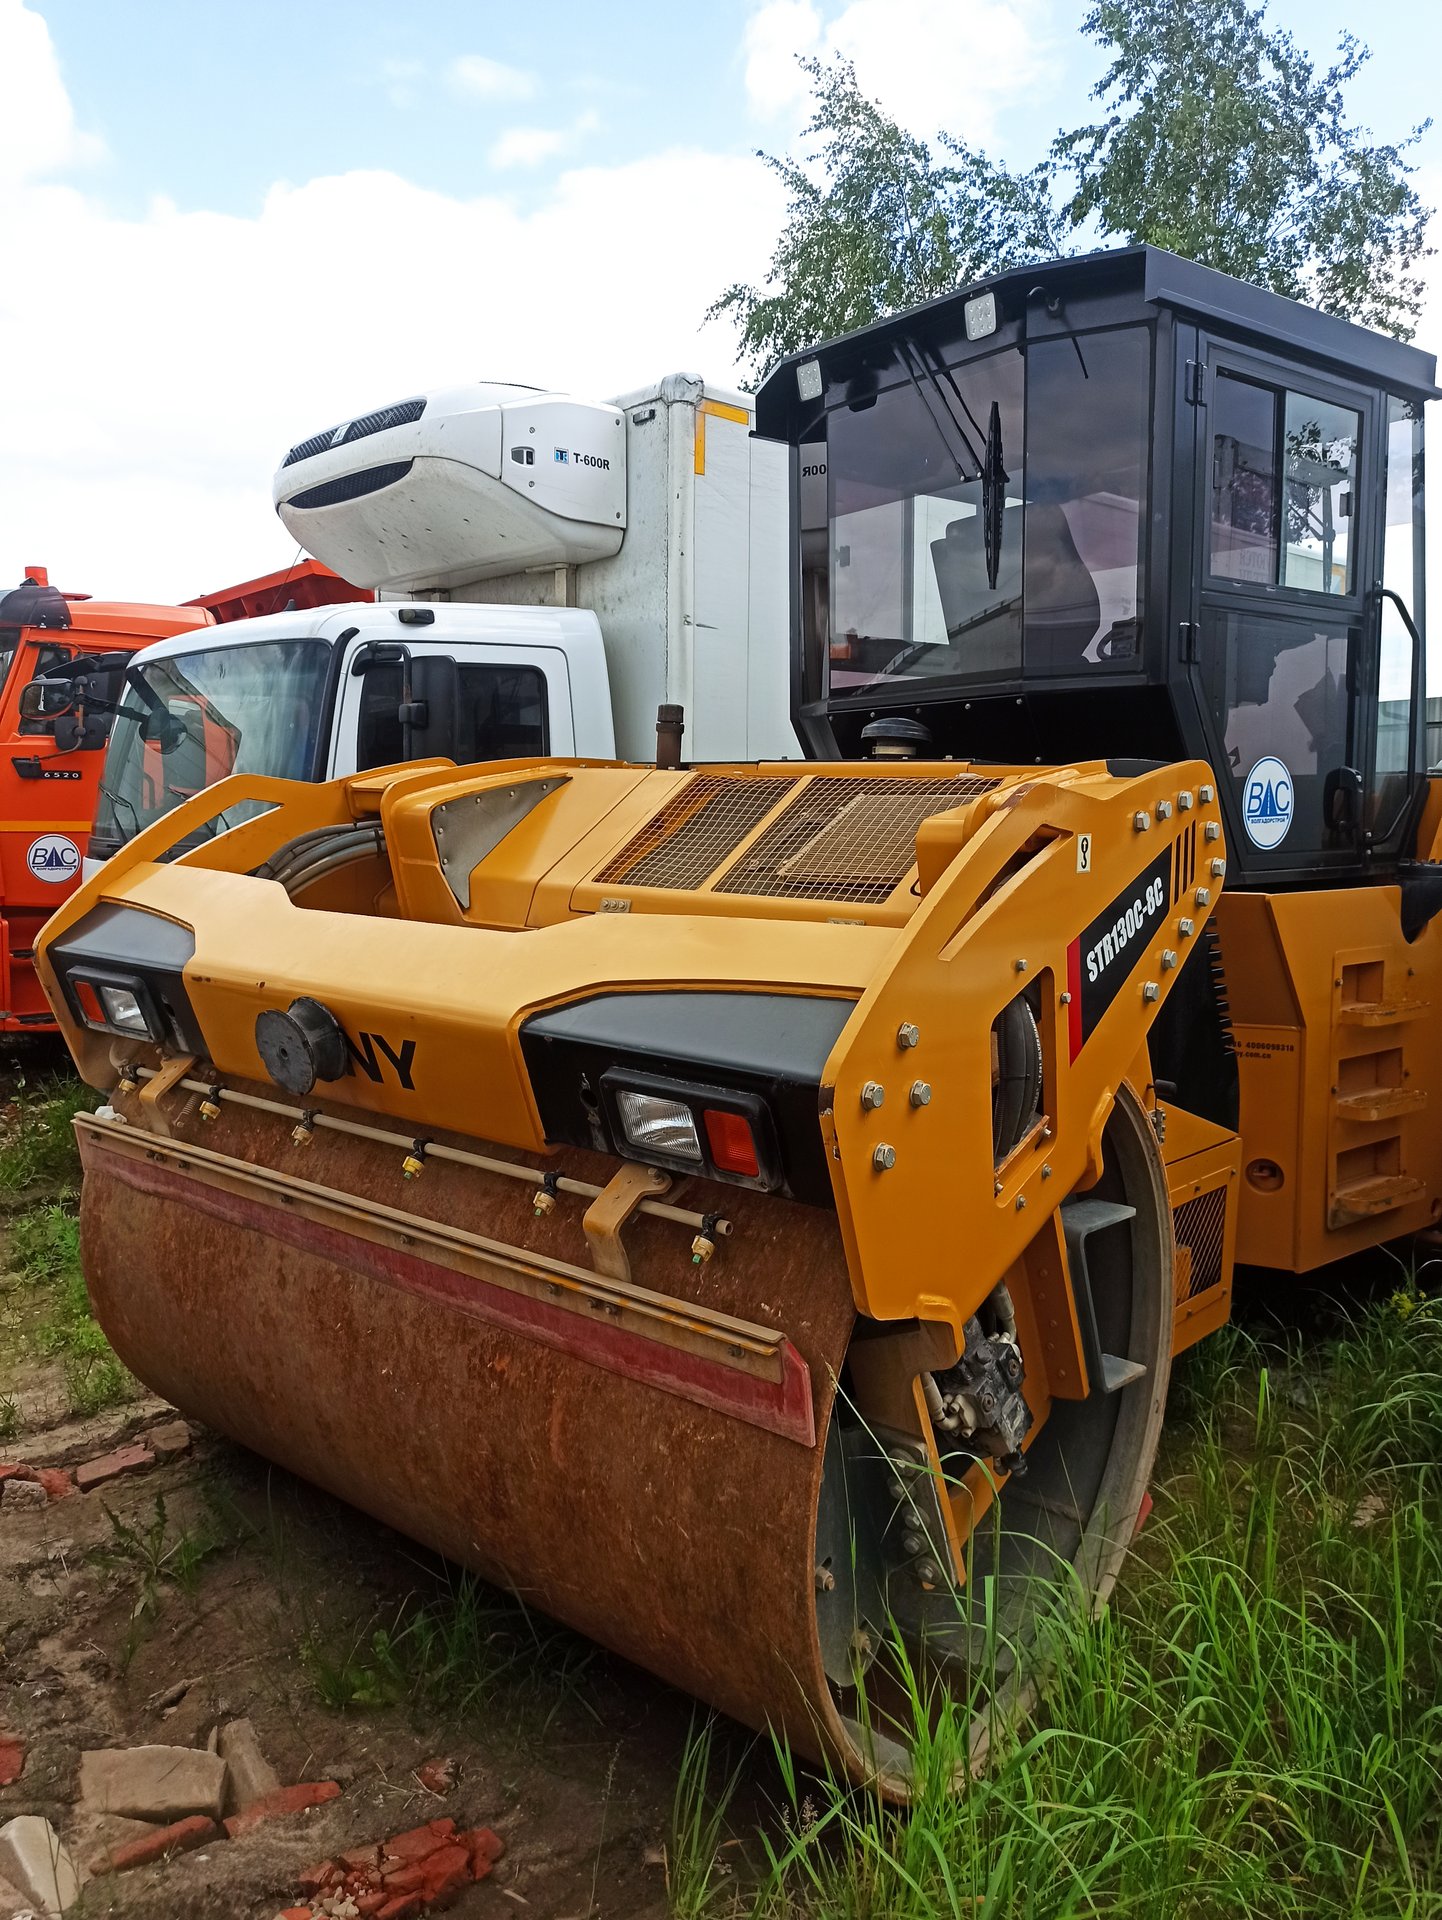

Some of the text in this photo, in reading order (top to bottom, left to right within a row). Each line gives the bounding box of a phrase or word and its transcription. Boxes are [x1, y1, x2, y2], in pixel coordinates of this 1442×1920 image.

[573, 452, 610, 470] T-600R
[44, 771, 79, 779] 6520
[1086, 876, 1164, 983] STR130C-8C
[346, 1030, 416, 1091] NY
